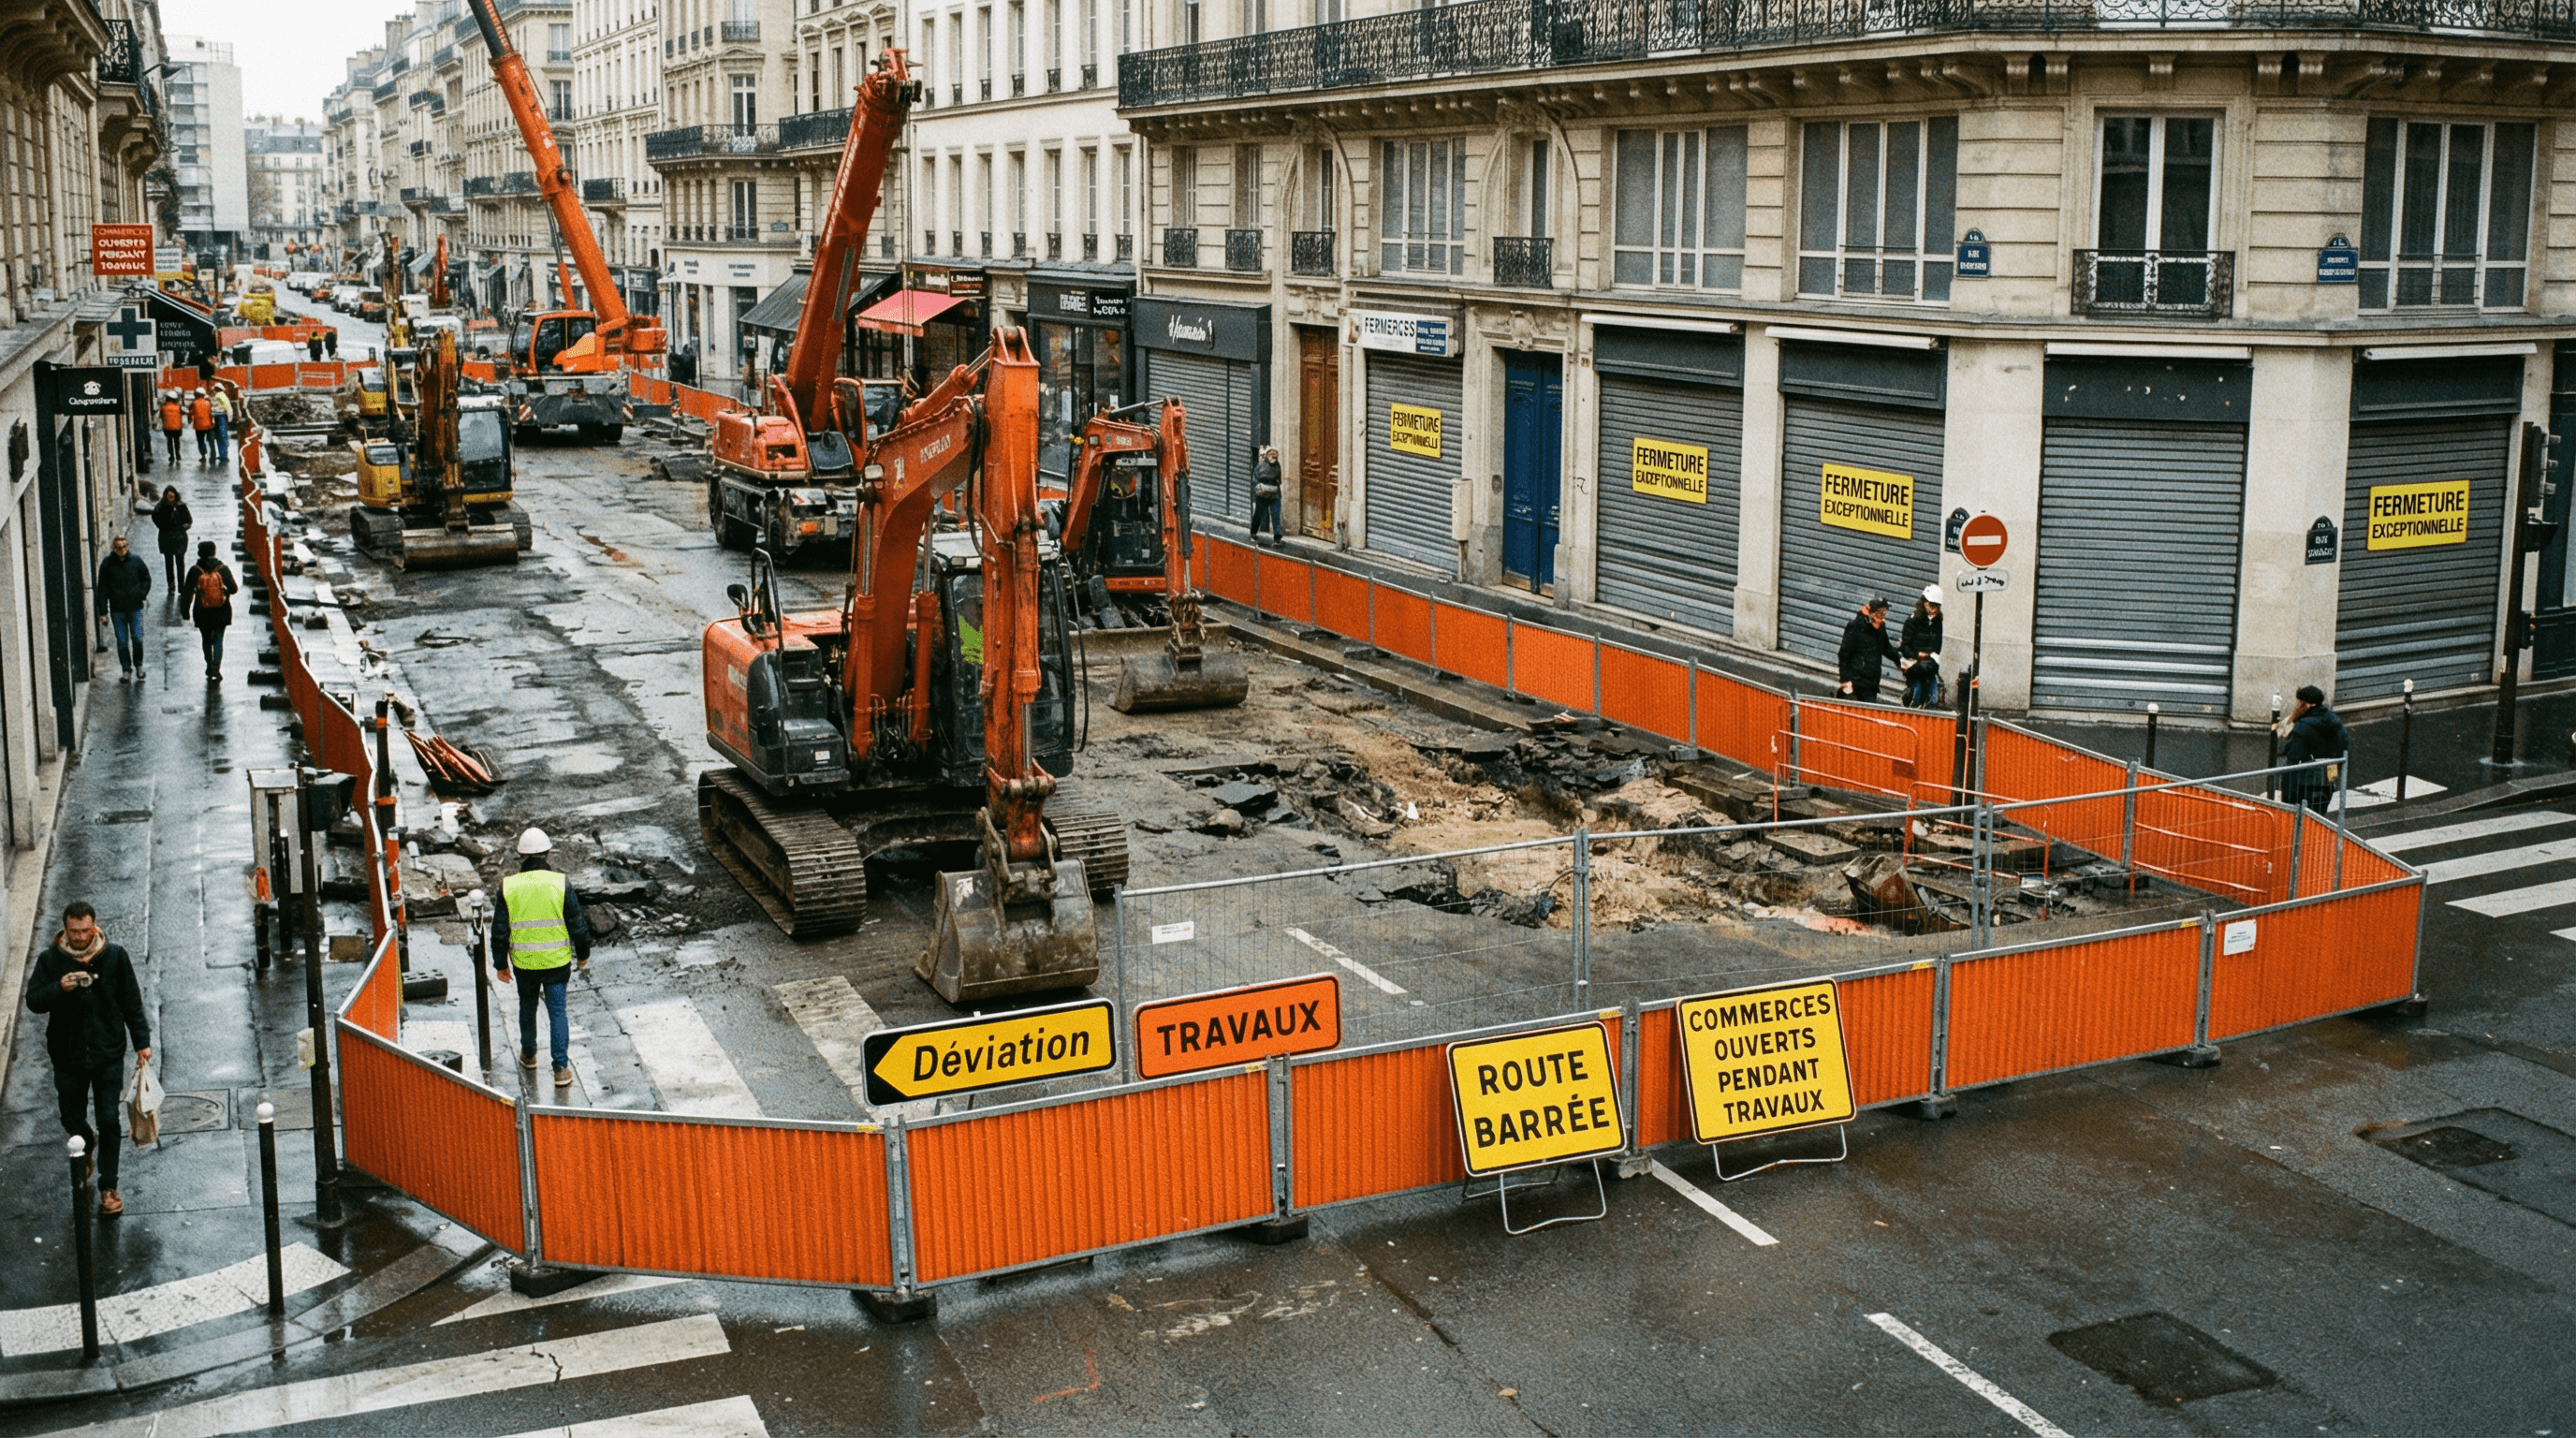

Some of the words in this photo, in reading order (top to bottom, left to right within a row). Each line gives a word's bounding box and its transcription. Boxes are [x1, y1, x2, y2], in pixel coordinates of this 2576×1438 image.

[1636, 446, 1704, 475] FERMETURE
[1825, 473, 1910, 506] FERMETURE
[2374, 490, 2465, 518] FERMETURE
[1824, 499, 1909, 528] EXCEPTIONNELLE
[2372, 518, 2464, 539] EXCEPTIONNELLE
[1157, 1000, 1323, 1057] TRAVAUX
[1689, 993, 1831, 1033] COMMERCES
[914, 1029, 1090, 1082] Déviation
[1714, 1027, 1816, 1061] OUVERTS
[1478, 1049, 1588, 1096] ROUTE
[1718, 1058, 1820, 1093] PENDANT
[1473, 1093, 1610, 1149] BARRÉE
[1722, 1090, 1825, 1125] TRAVAUX
